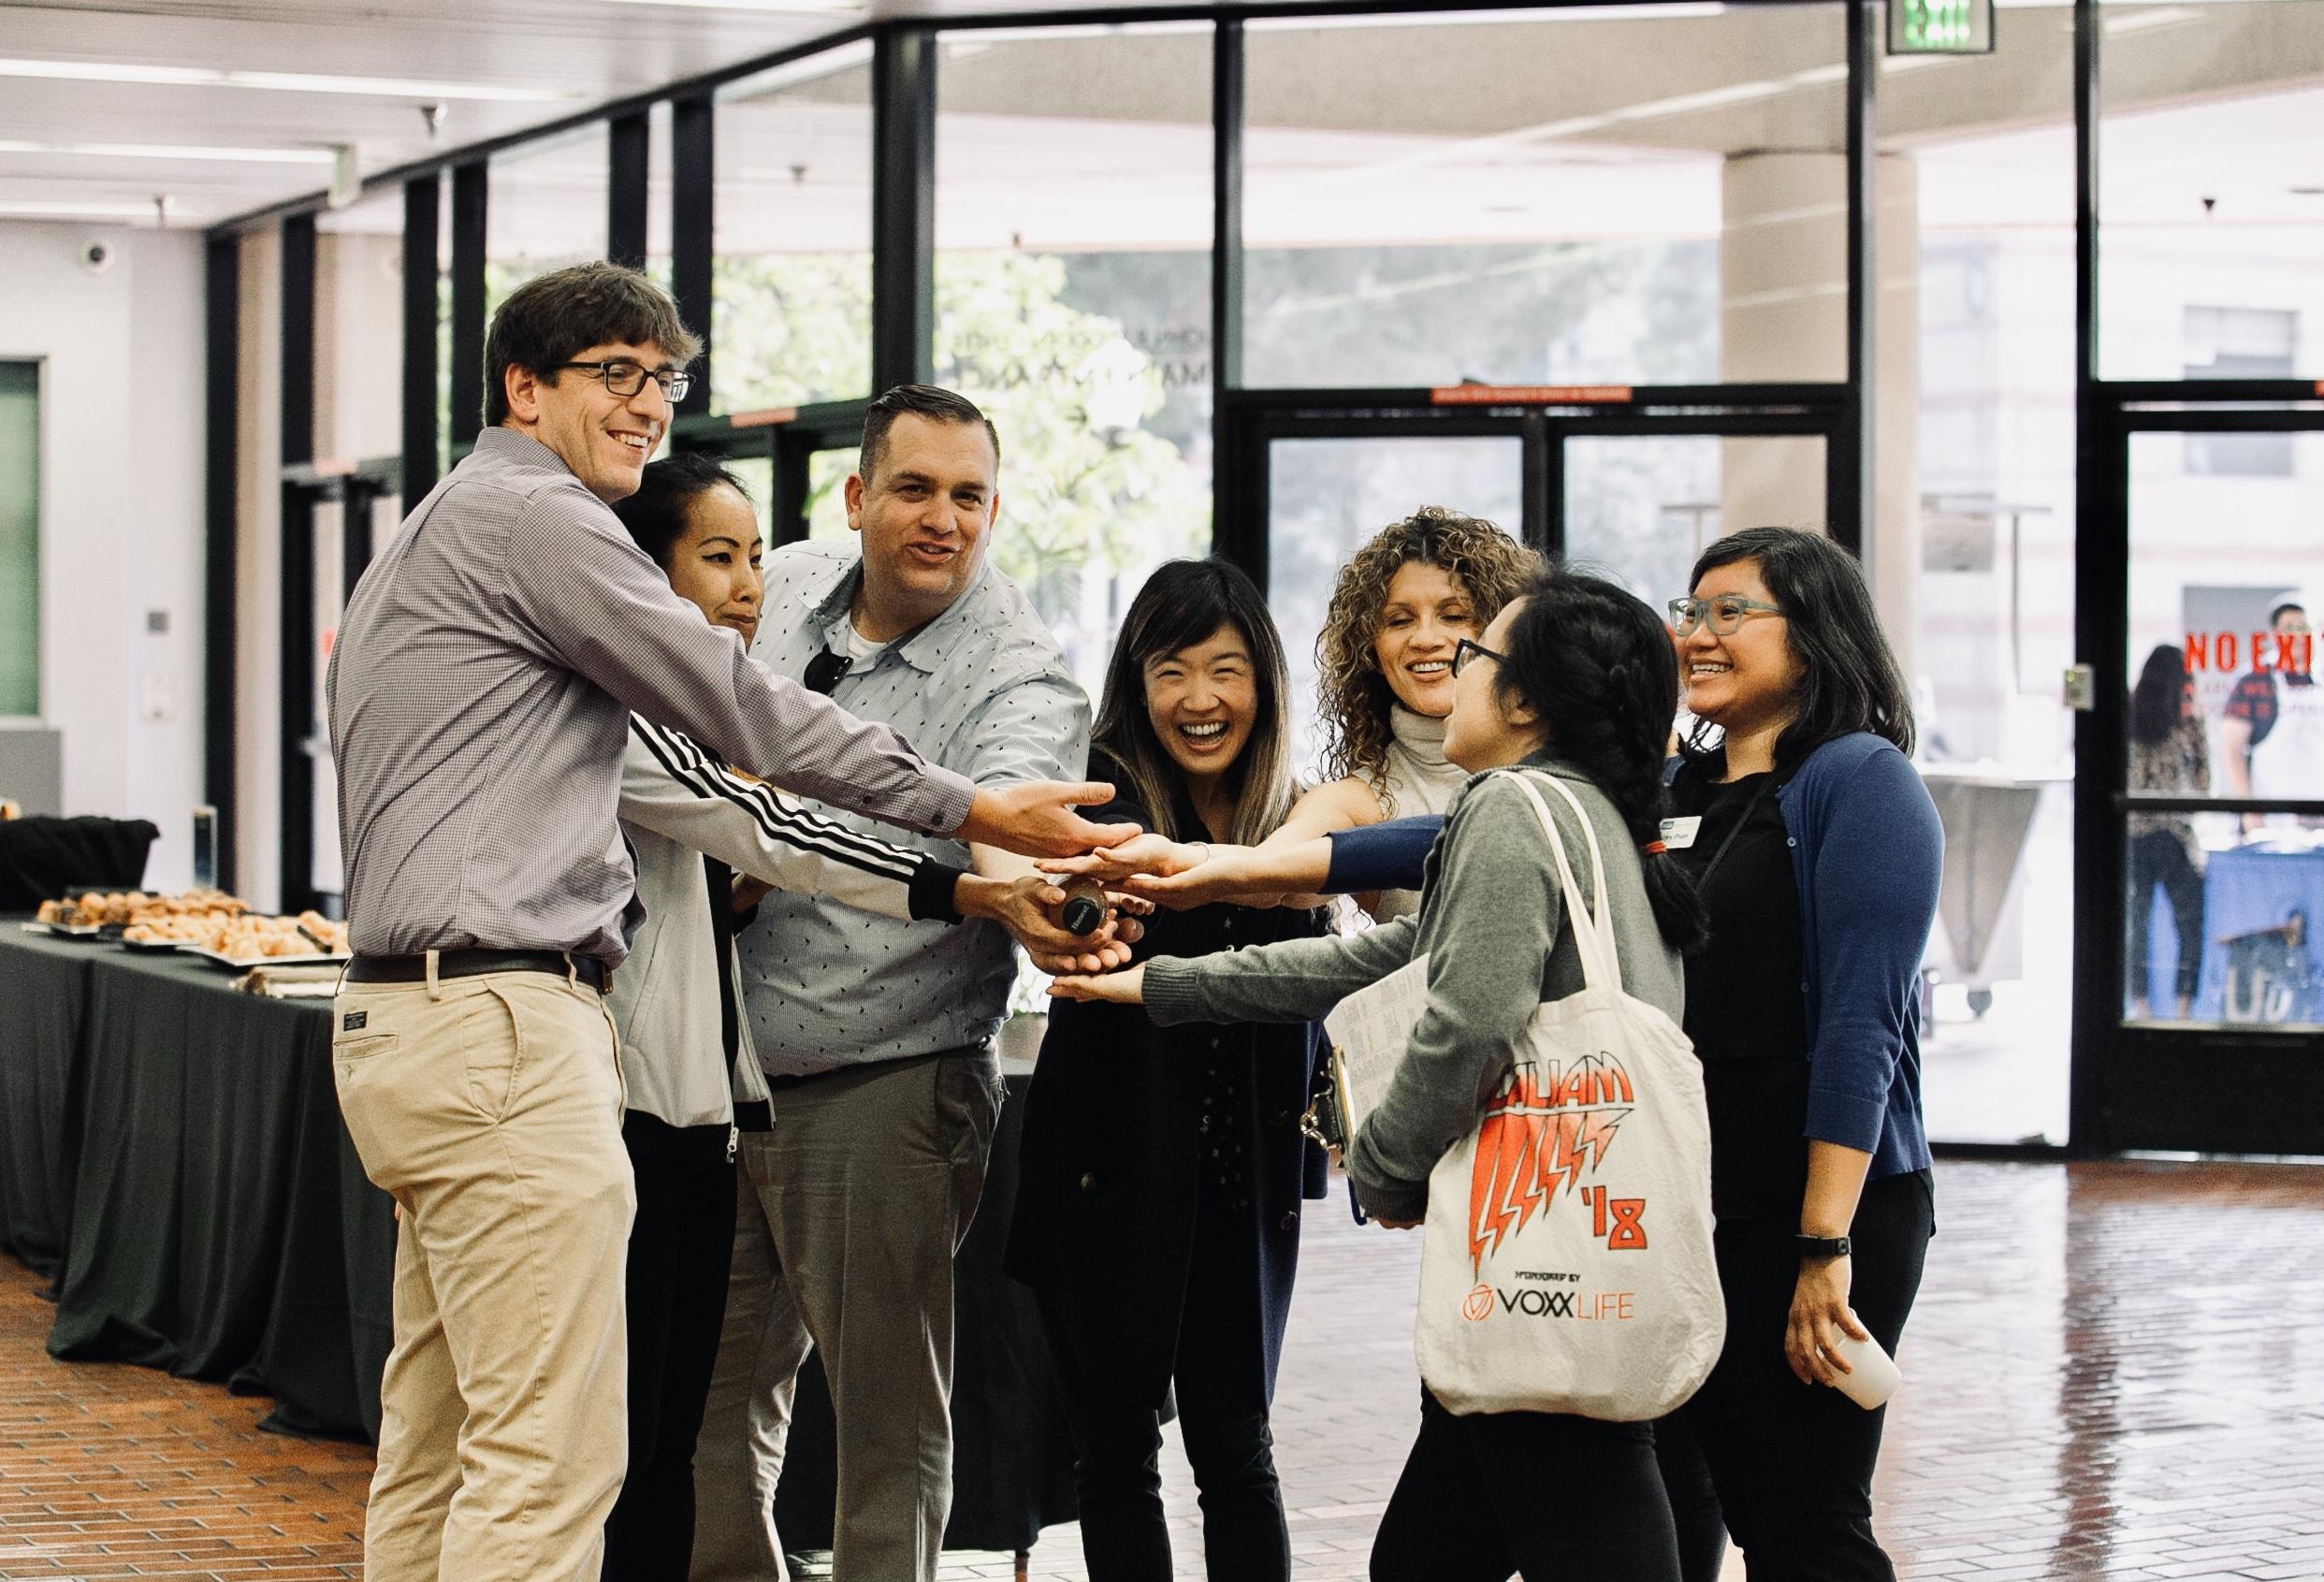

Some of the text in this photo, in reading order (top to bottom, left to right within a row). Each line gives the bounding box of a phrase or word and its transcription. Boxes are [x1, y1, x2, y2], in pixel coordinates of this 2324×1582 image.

[2184, 631, 2324, 675] NO EXI
[1581, 1185, 1648, 1251] '18
